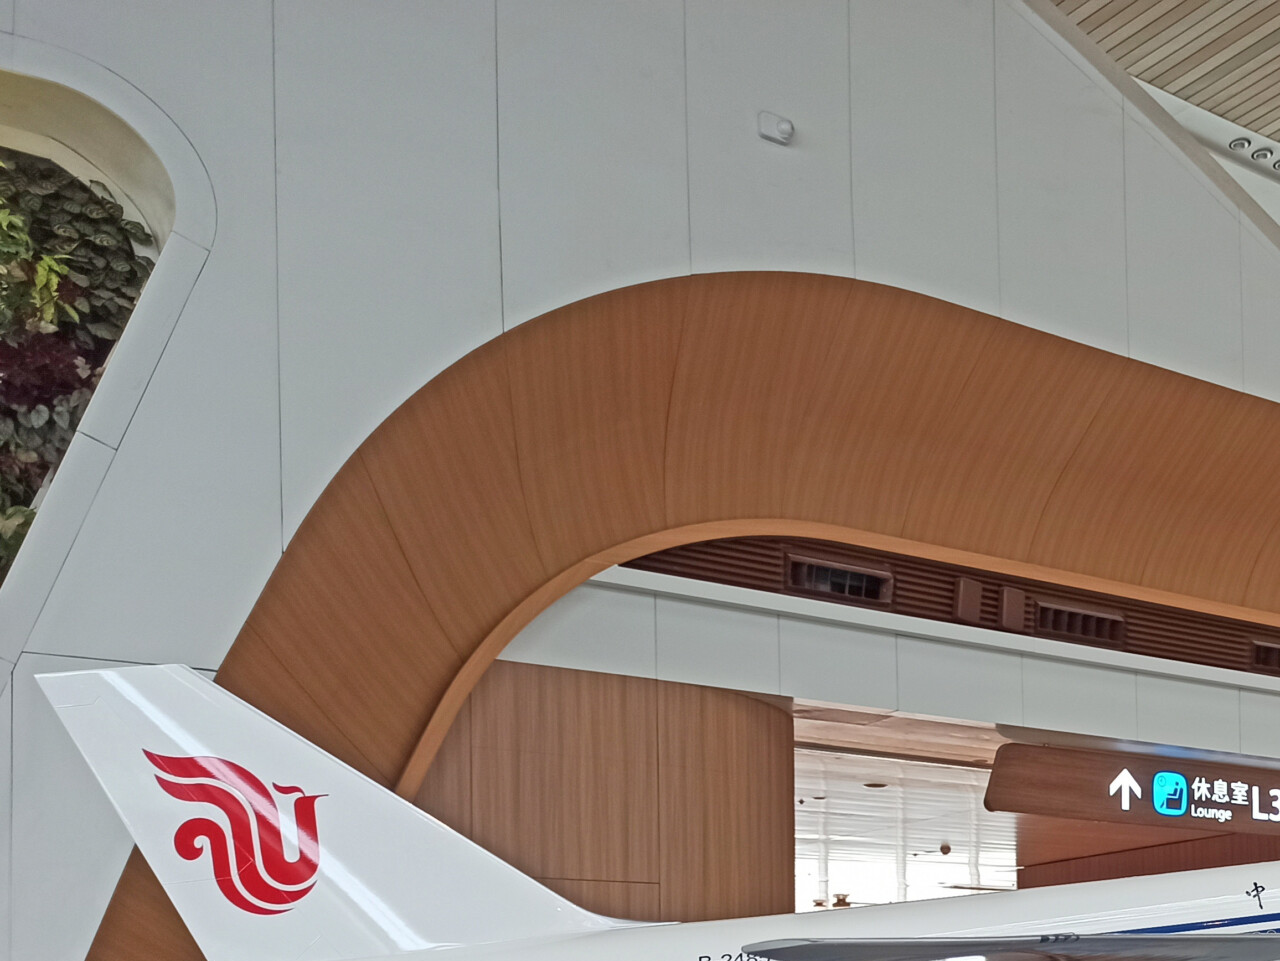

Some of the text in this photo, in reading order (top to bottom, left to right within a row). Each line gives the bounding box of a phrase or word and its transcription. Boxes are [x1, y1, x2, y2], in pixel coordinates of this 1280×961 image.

[1191, 776, 1249, 805] 休息室
[1191, 804, 1233, 823] Lounge
